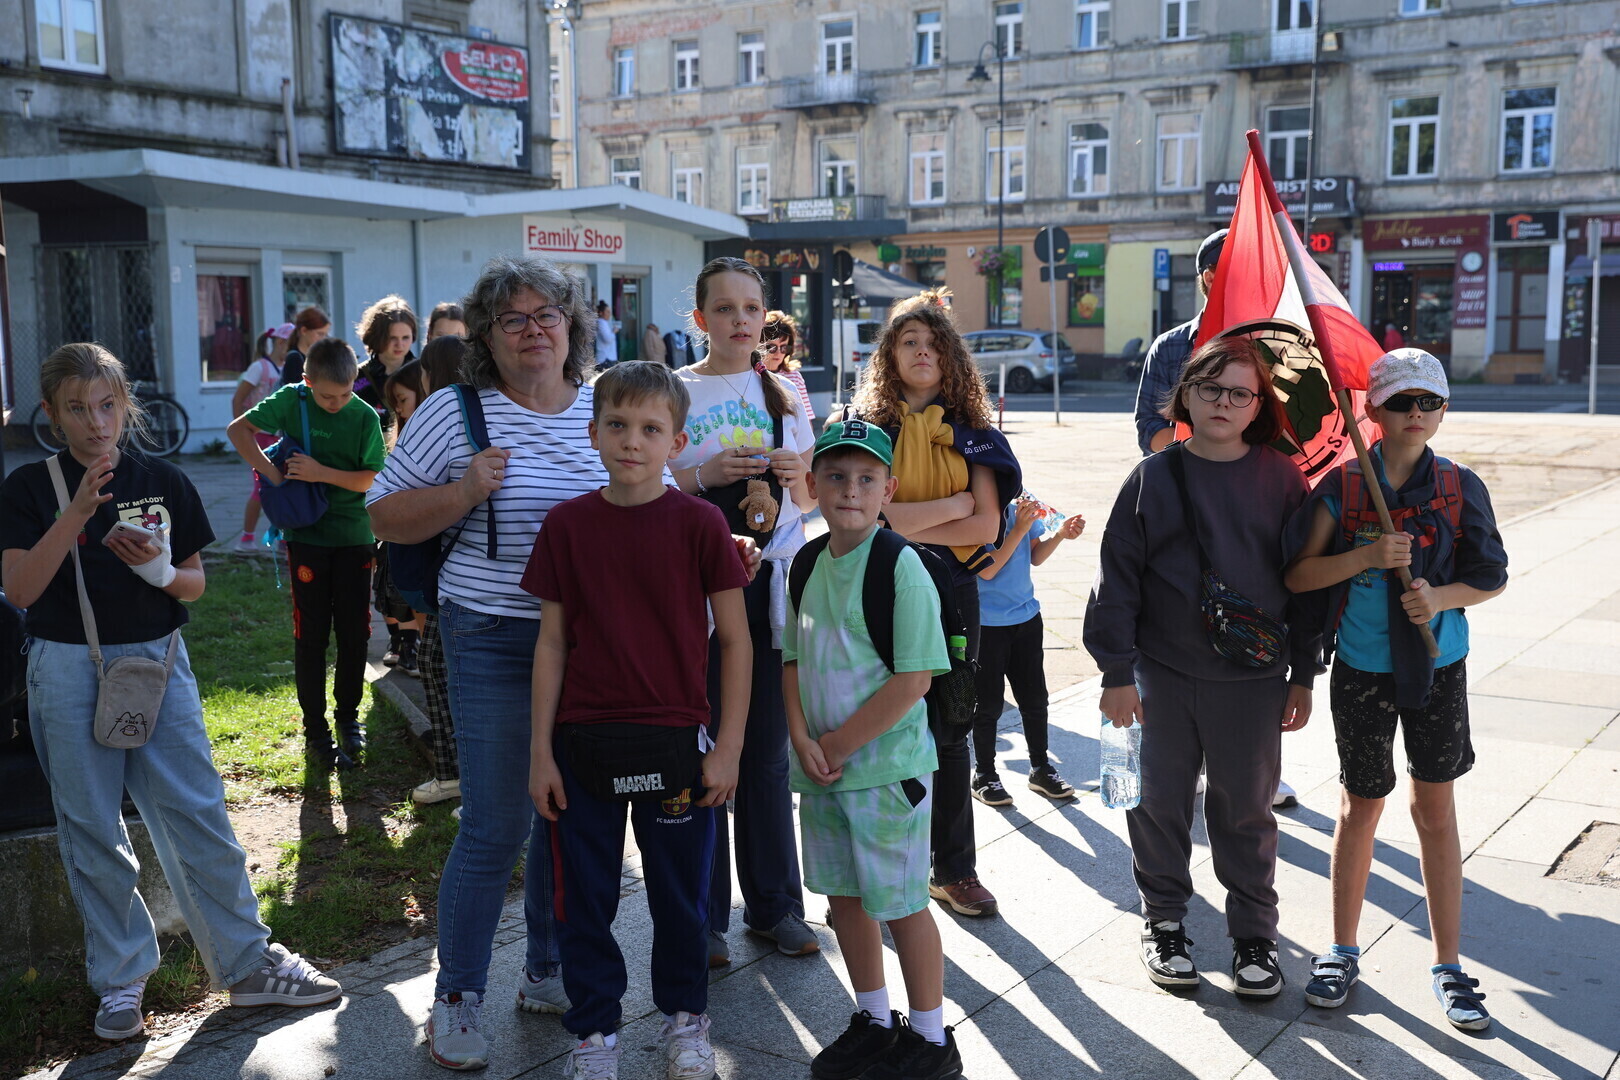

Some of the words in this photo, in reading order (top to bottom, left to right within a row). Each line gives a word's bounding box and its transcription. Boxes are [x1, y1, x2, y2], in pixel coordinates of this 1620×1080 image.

[528, 225, 579, 251] Family
[584, 228, 623, 253] Shop
[1157, 251, 1167, 269] P
[840, 420, 869, 440] B
[964, 447, 973, 455] GO
[116, 501, 131, 509] MY
[132, 496, 164, 507] MELODY
[613, 773, 665, 794] MARVEL
[663, 815, 693, 824] BARCELONA
